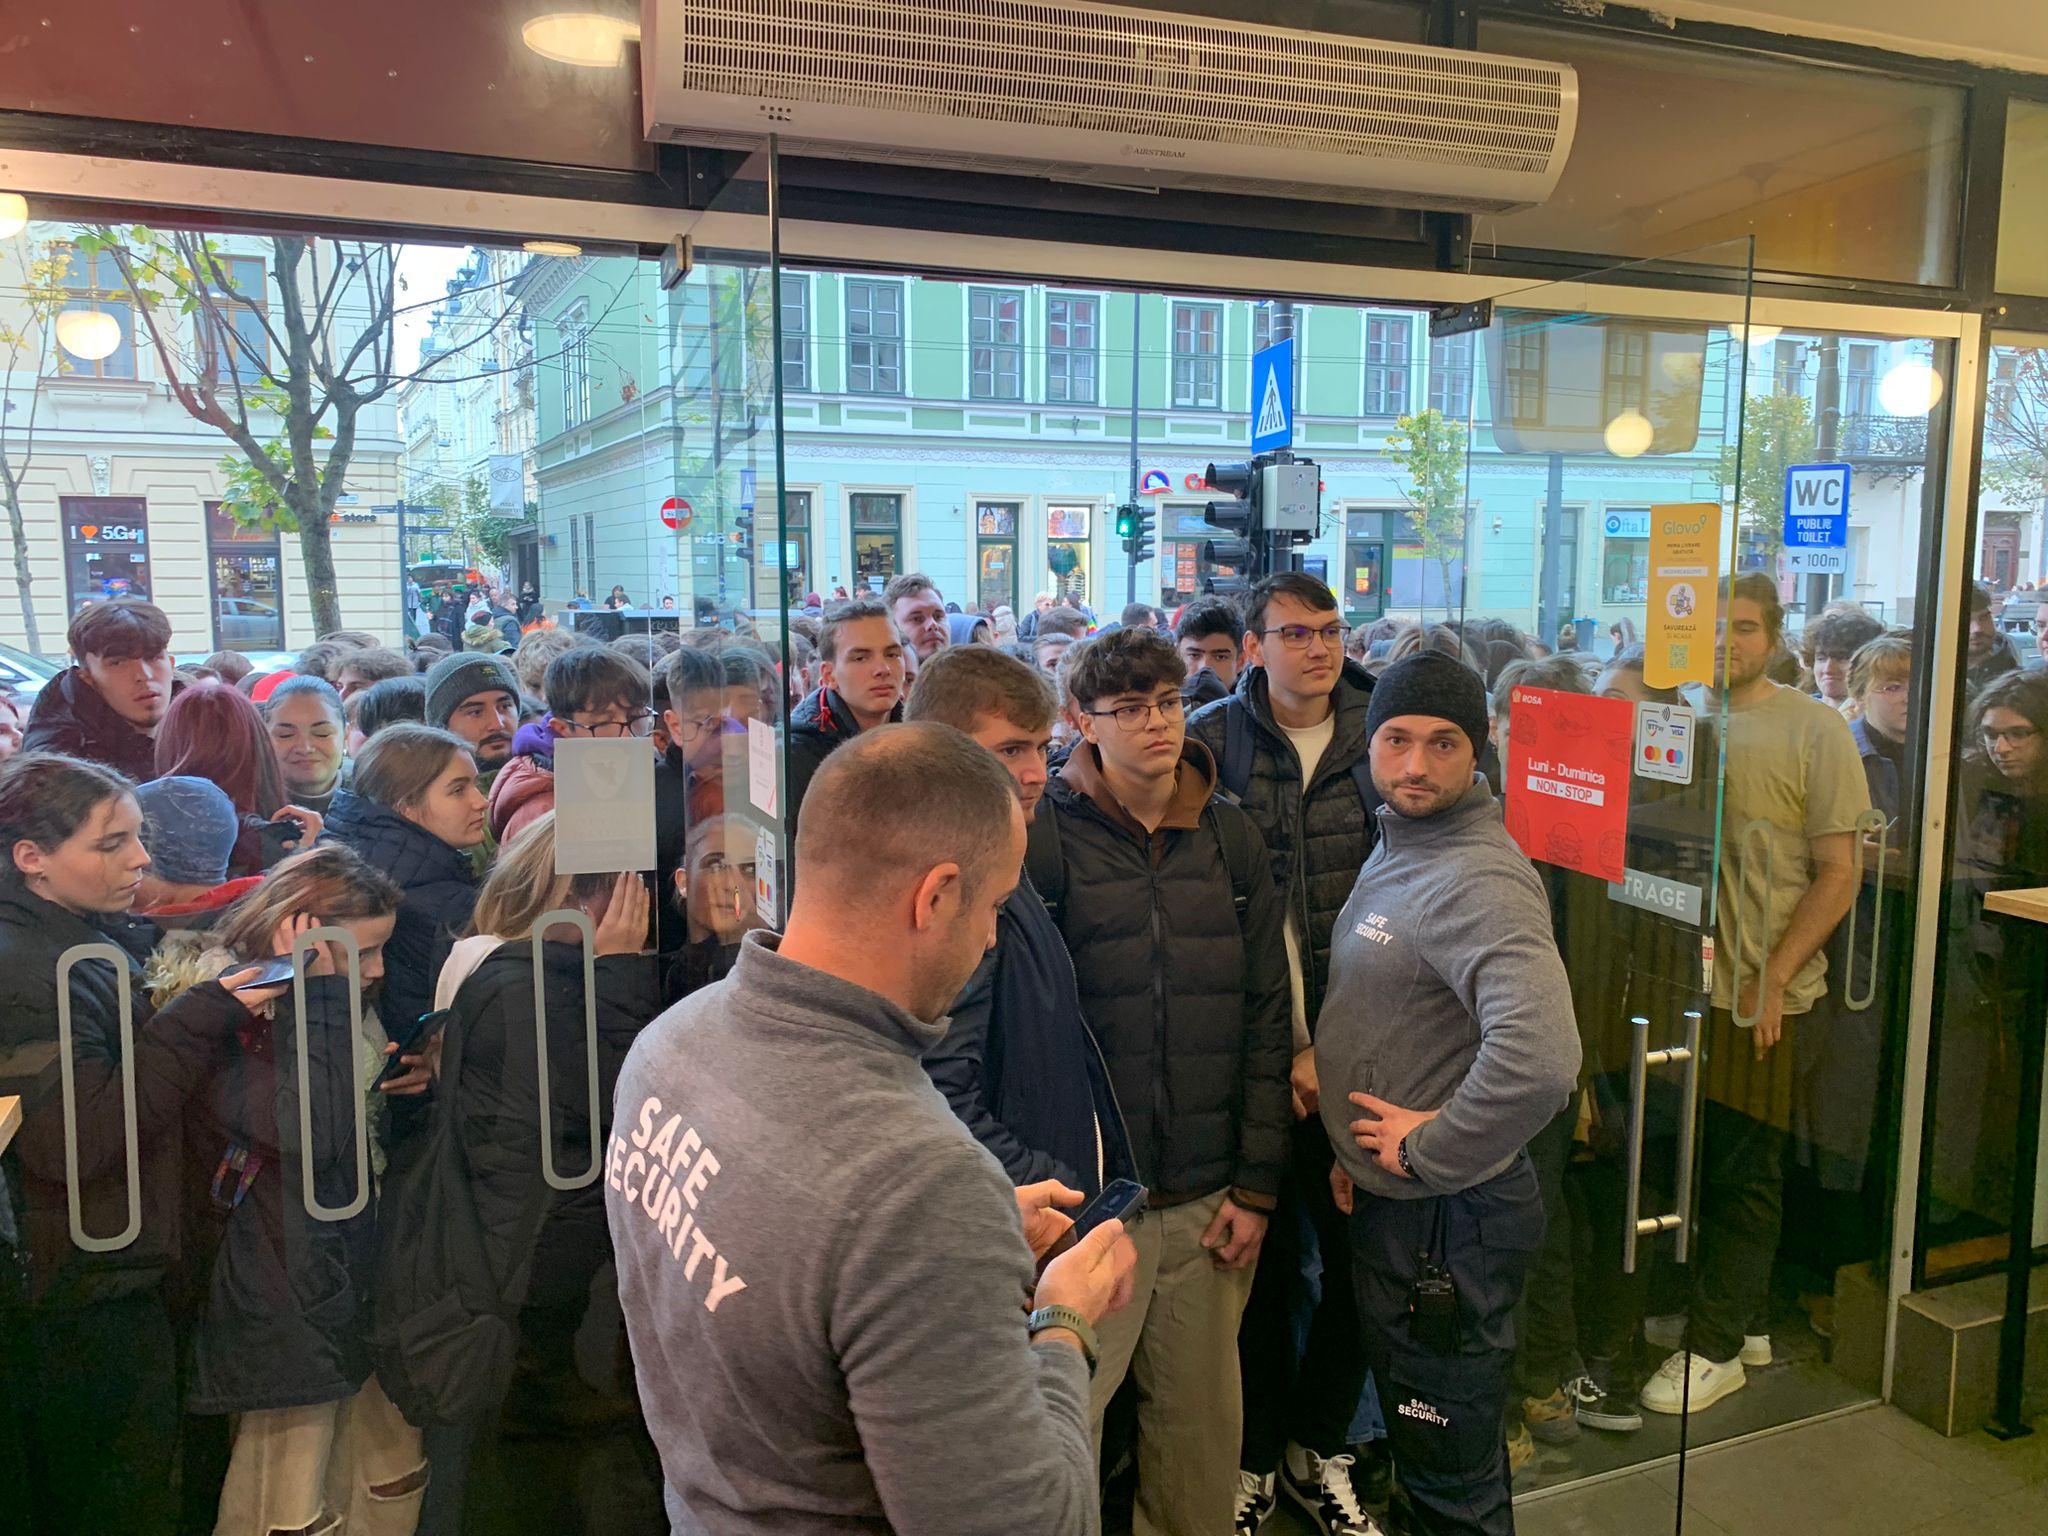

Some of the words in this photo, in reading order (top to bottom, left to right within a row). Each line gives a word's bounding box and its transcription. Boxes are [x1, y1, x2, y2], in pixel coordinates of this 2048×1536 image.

[1133, 147, 1186, 158] AIRSTREAM
[1795, 479, 1840, 506] WC
[343, 513, 377, 521] store
[1662, 520, 1701, 535] Glovo
[1797, 531, 1831, 543] TOILET
[1807, 553, 1839, 567] 100m
[1522, 693, 1543, 705] ROSA
[1528, 757, 1550, 773] Luni
[1558, 763, 1605, 785] Duminica
[1536, 779, 1558, 797] NON
[1565, 785, 1592, 802] STOP
[1624, 876, 1687, 912] TRAGE
[1365, 912, 1388, 928] SAFE
[631, 1096, 722, 1211] SAFE
[1410, 1398, 1437, 1414] SAFE
[1397, 1404, 1449, 1427] SECURITY
